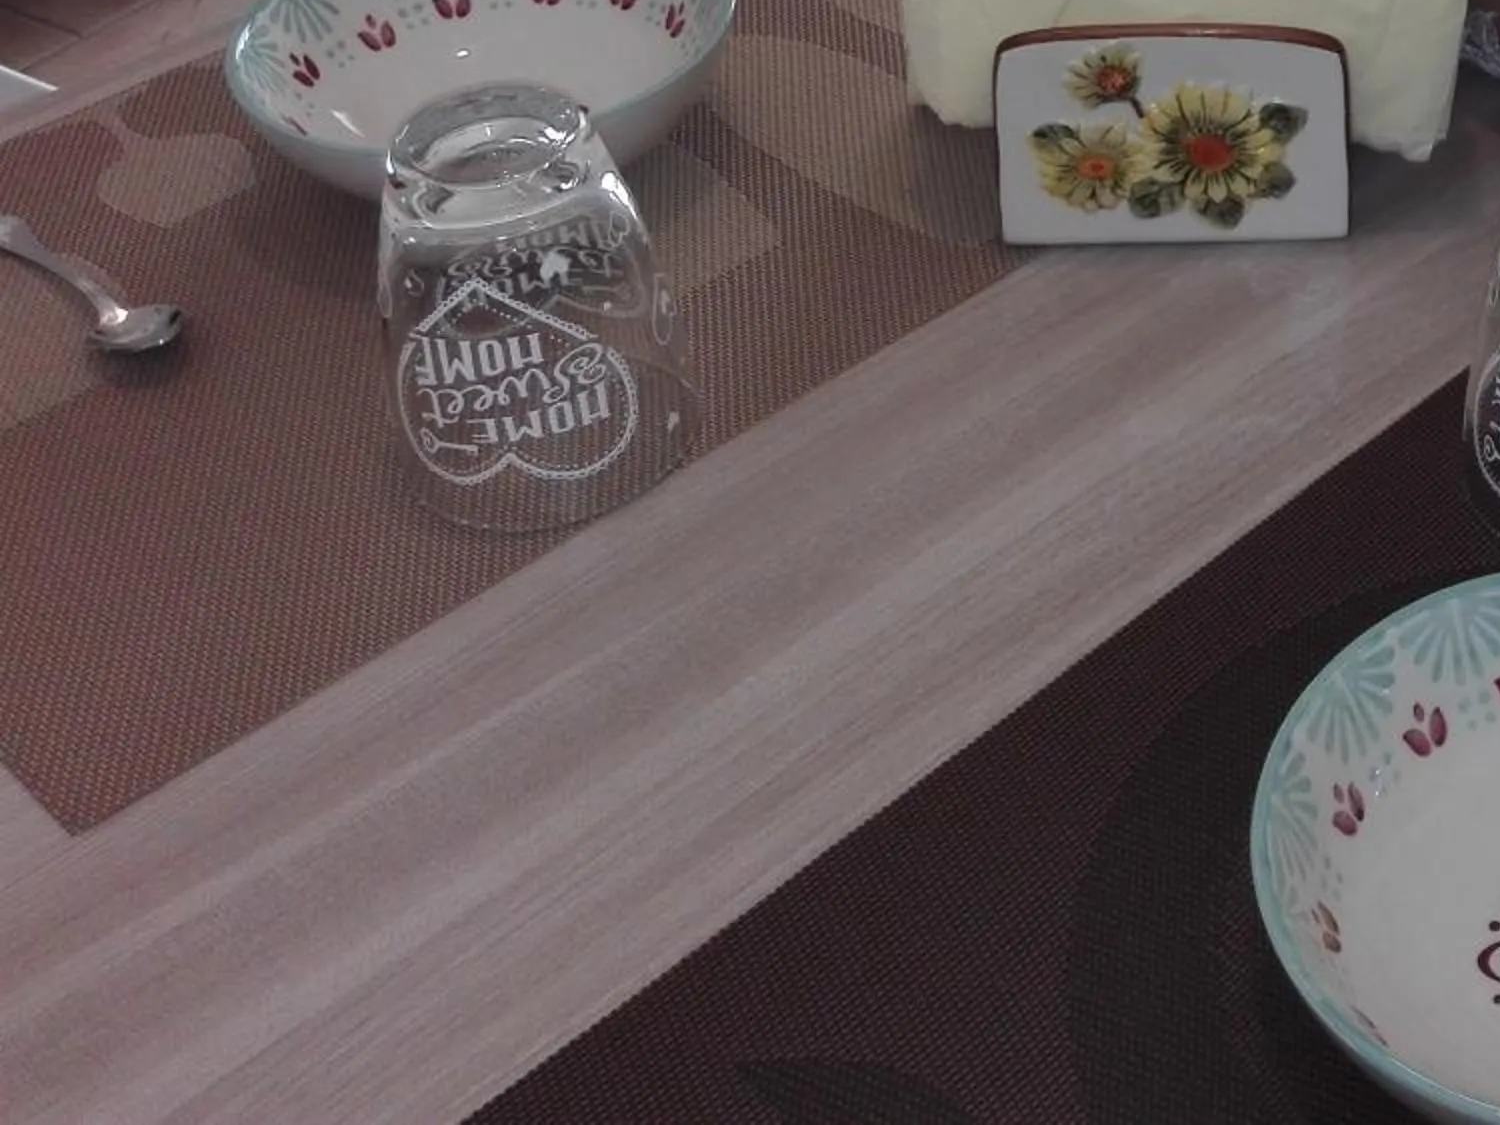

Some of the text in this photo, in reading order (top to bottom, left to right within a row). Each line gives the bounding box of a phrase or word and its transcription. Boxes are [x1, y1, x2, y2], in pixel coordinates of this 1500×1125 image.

[412, 332, 544, 386] HOME
[415, 342, 607, 430] Sweet
[467, 380, 610, 444] HOME
